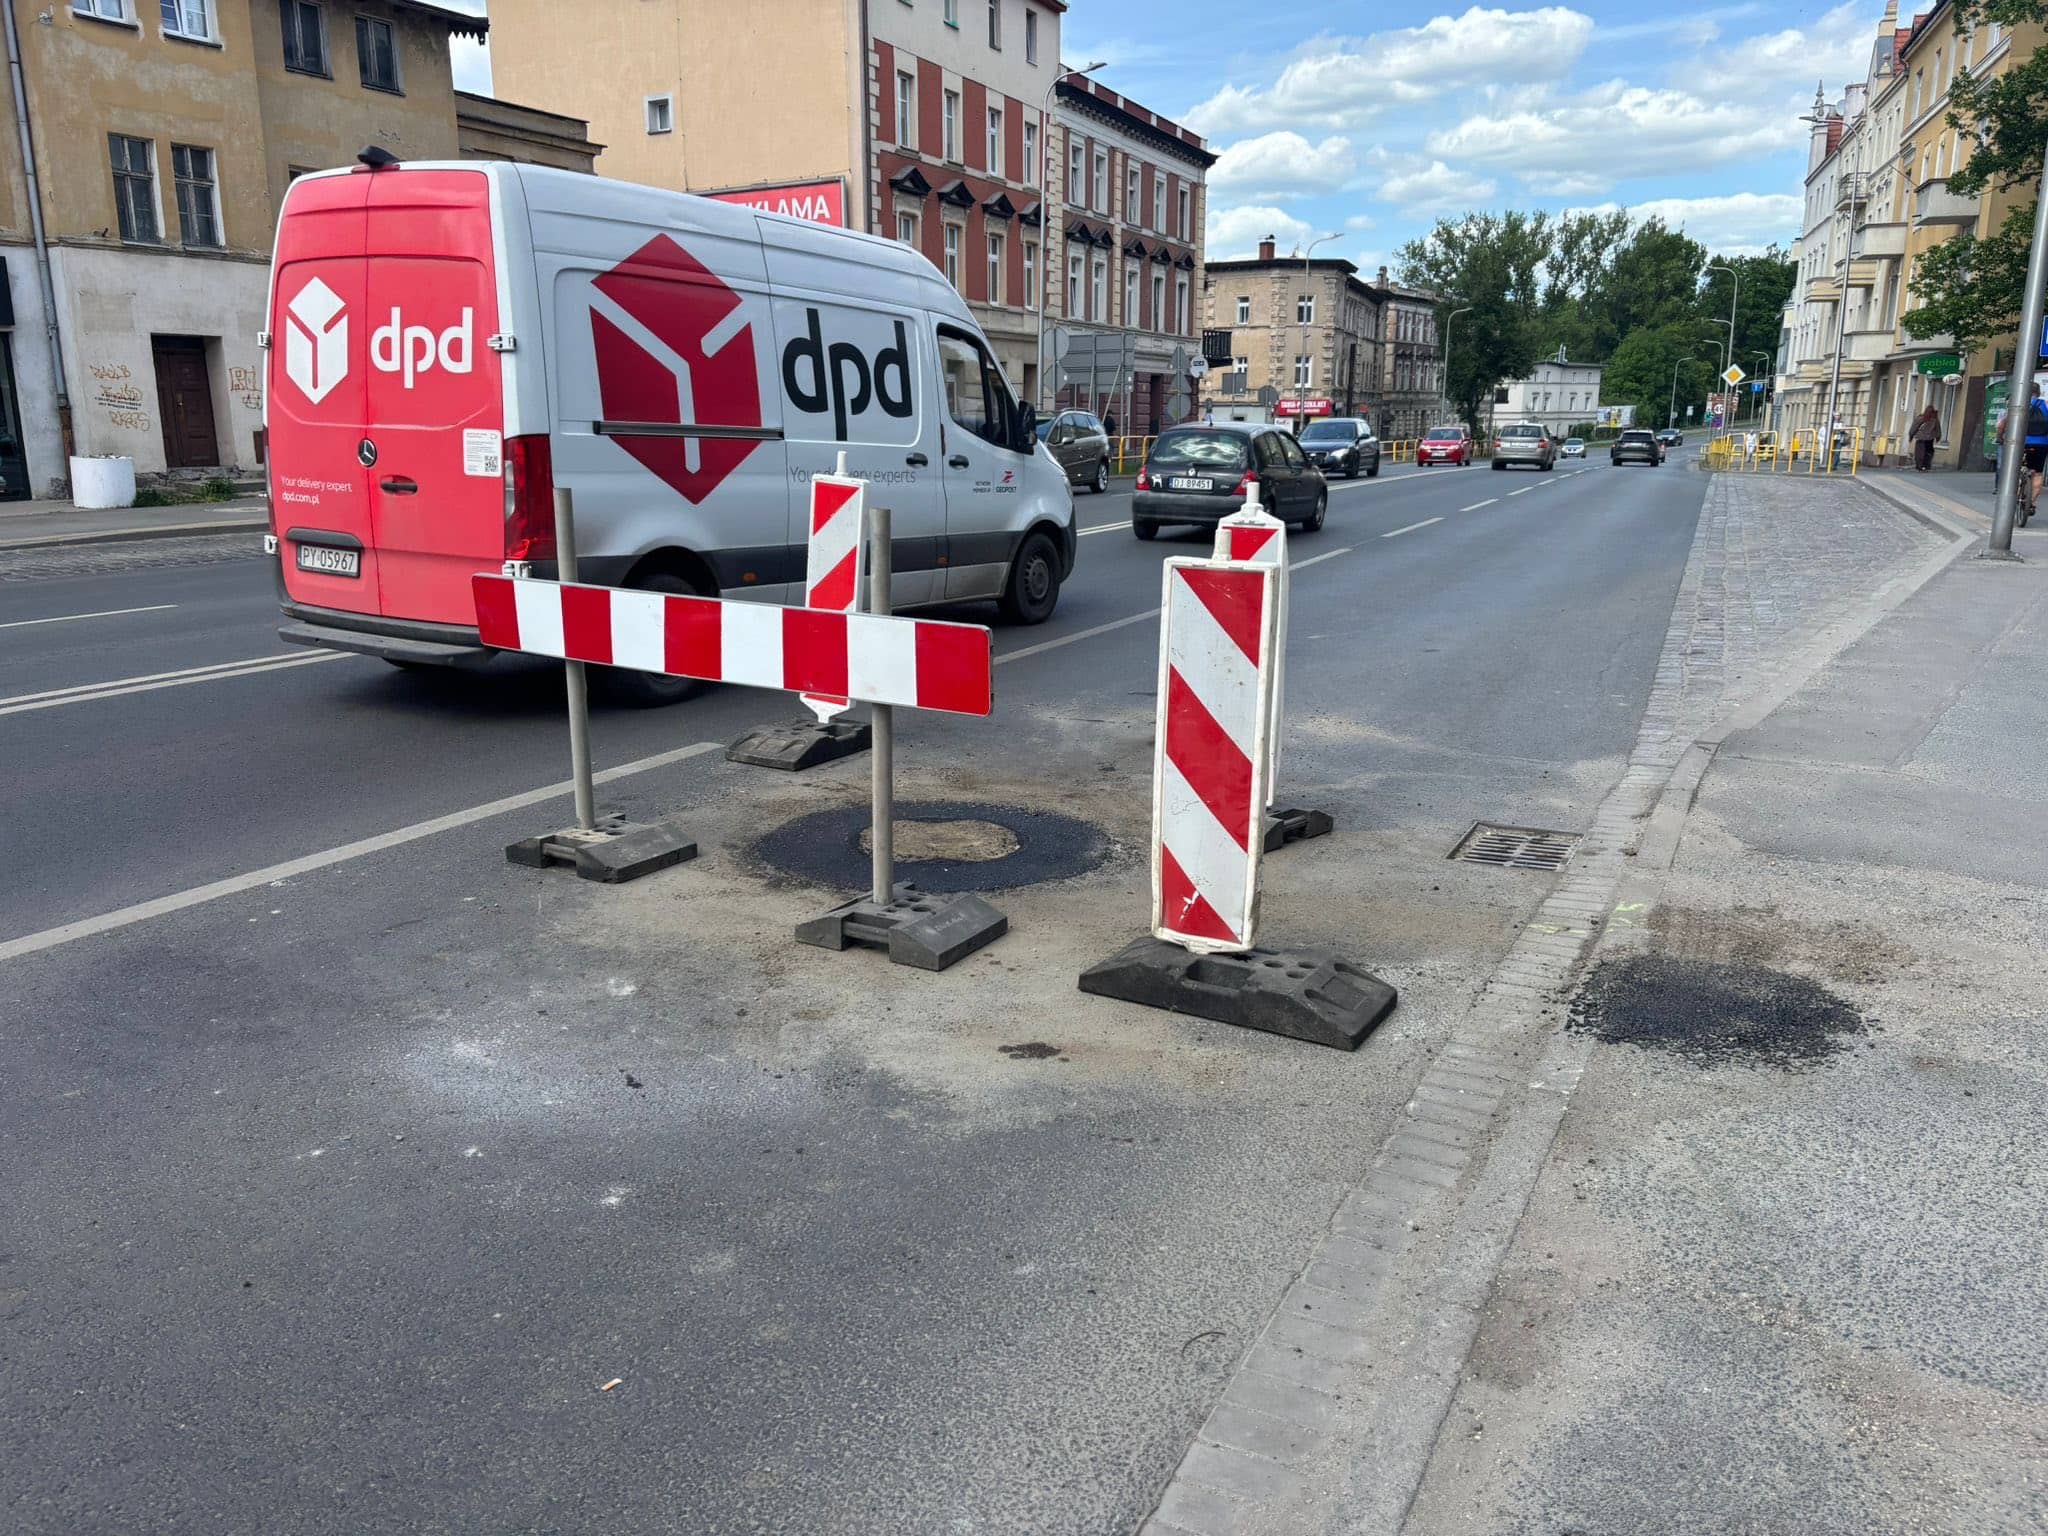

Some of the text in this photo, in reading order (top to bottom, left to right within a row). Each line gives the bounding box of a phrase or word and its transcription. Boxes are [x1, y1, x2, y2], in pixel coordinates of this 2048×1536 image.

[370, 306, 473, 389] dpd
[782, 307, 913, 441] dpd
[280, 475, 296, 487] Your
[296, 477, 325, 492] delivery
[873, 470, 916, 486] experts
[1186, 479, 1210, 489] 89451
[282, 491, 320, 505] dpd.com.pl
[303, 547, 355, 571] PY 05967
